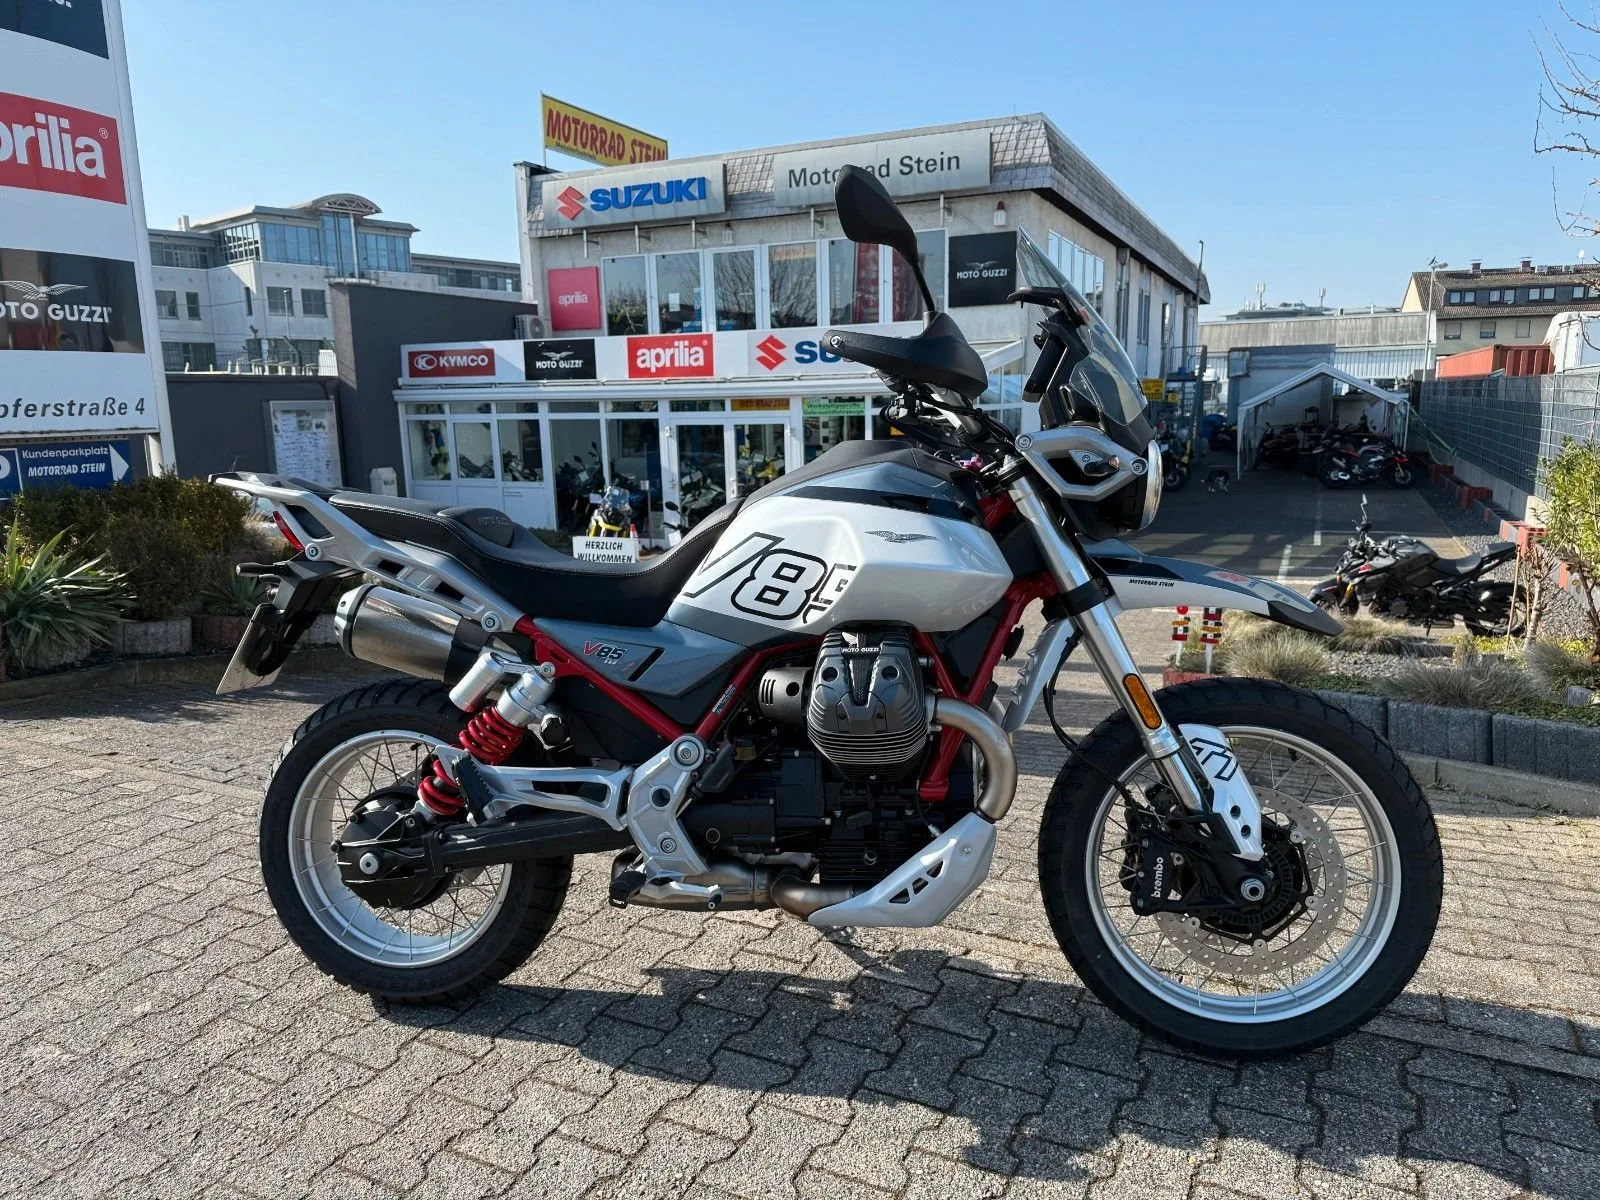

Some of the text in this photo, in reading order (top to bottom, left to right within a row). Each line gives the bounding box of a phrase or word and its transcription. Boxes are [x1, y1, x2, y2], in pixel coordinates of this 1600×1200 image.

[546, 108, 625, 160] MOTORRAD
[630, 139, 665, 164] STEIN
[899, 152, 961, 176] Stein
[590, 176, 706, 211] SUZUKI
[956, 268, 1008, 279] MOTO GUZZI
[559, 291, 588, 306] aprilia
[48, 303, 109, 324] GUZZI
[439, 354, 489, 368] KYMCO
[636, 340, 705, 373] aprilia
[535, 359, 583, 370] MOTO GUZZI
[135, 397, 145, 415] 4
[22, 446, 109, 460] Kundenparkplatz
[28, 463, 106, 477] MOTORRAD STEIN
[585, 541, 623, 551] HERZLICH
[577, 552, 632, 563] WILLKOMMEN
[1128, 578, 1158, 587] MOTORRAD
[583, 640, 628, 660] V85
[1151, 856, 1164, 898] brembo
